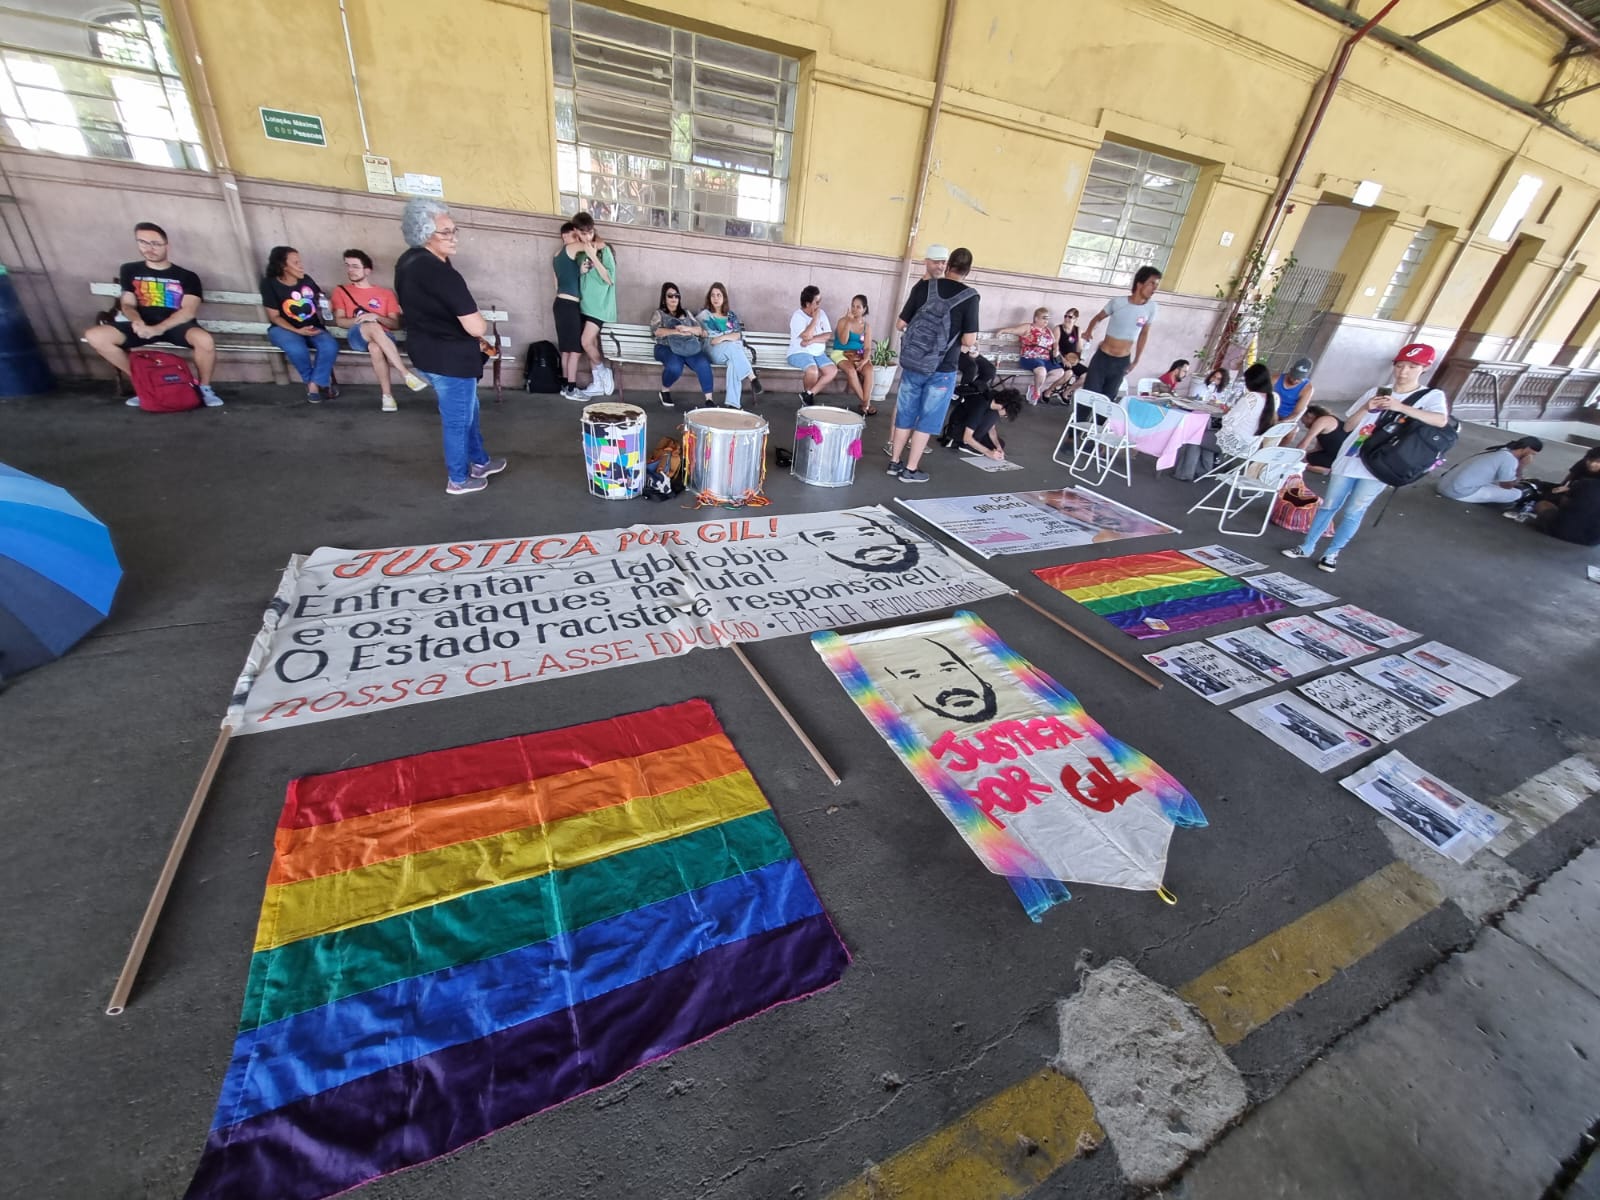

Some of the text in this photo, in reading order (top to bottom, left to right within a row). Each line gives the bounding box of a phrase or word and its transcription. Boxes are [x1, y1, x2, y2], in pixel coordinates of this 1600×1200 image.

[333, 517, 778, 579] JUSTIÇA POR GIL!
[573, 570, 596, 585] a
[611, 546, 789, 584] lgbtfobia
[275, 649, 329, 683] O
[350, 626, 520, 671] Estado
[536, 603, 677, 644] racista
[726, 565, 946, 611] responsável!
[292, 564, 778, 646] e os ataques na luta!
[257, 673, 448, 722] nossa
[465, 639, 639, 687] CLASSE
[965, 757, 1143, 830] POR GIL
